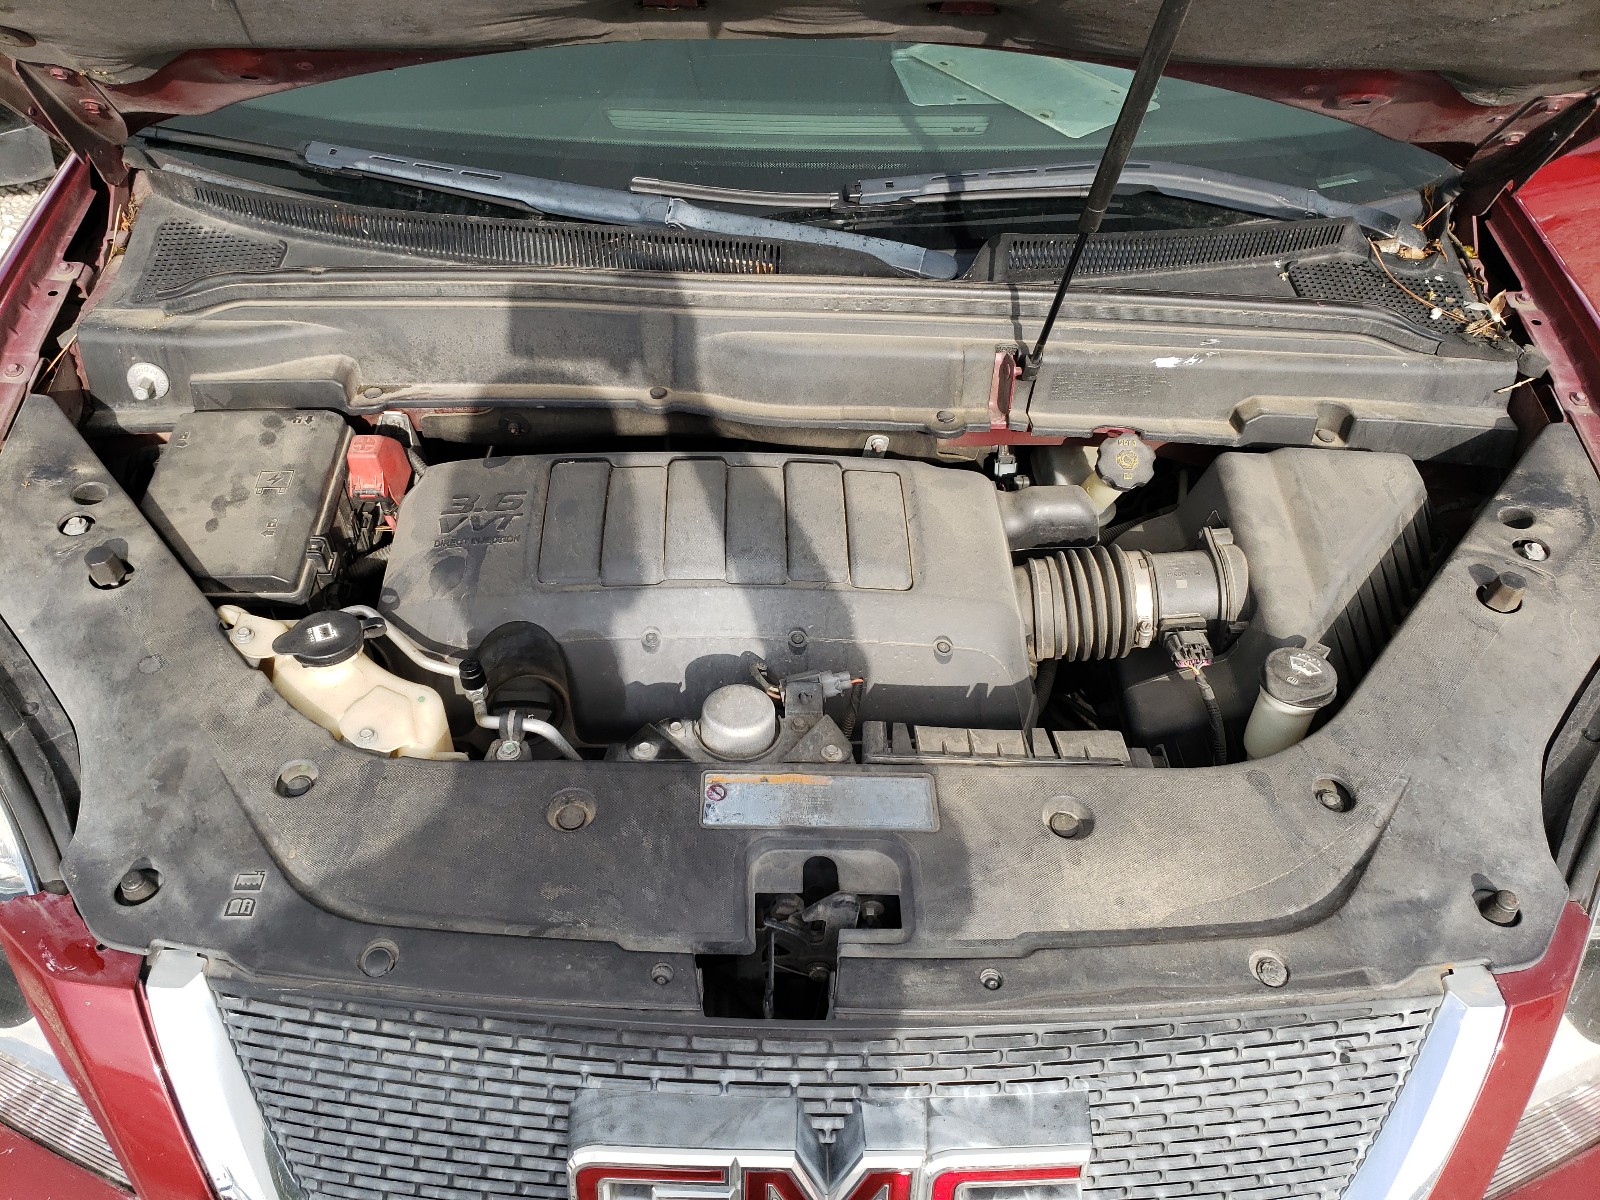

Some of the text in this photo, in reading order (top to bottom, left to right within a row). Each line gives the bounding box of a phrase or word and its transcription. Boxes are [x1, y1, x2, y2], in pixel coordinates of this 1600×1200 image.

[441, 491, 527, 515] 3.6
[439, 512, 524, 535] VVT
[434, 535, 521, 548] DIRECT INJECTION
